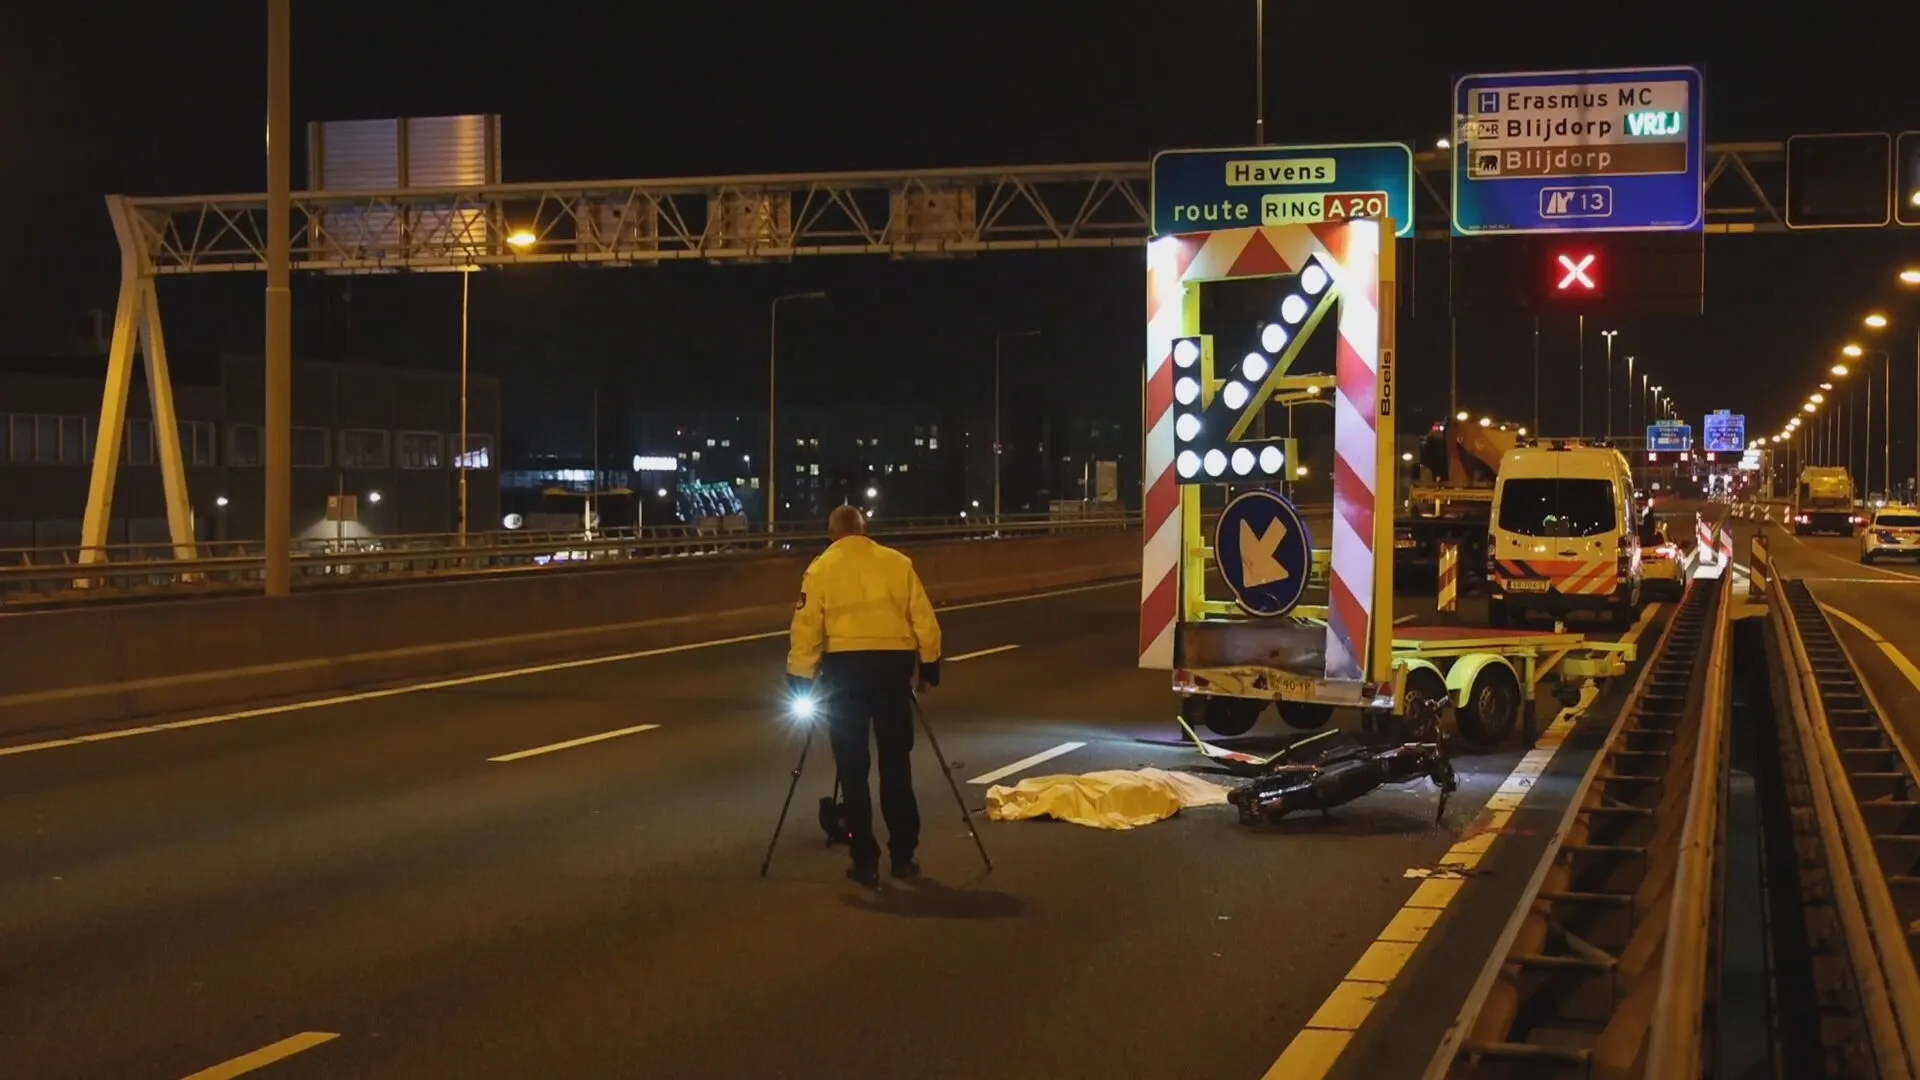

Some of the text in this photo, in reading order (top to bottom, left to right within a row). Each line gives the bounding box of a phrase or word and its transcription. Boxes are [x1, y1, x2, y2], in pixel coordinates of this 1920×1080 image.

[1507, 92, 1608, 111] Erasmus
[1618, 88, 1652, 106] MC
[1478, 118, 1612, 141] P+R Blijdorp
[1627, 112, 1681, 136] VRIJ
[1234, 164, 1326, 182] Havens
[1506, 150, 1612, 173] Blijdorp
[1173, 198, 1382, 222] route RING A20
[1581, 193, 1604, 210] 13
[1381, 351, 1391, 416] Boels
